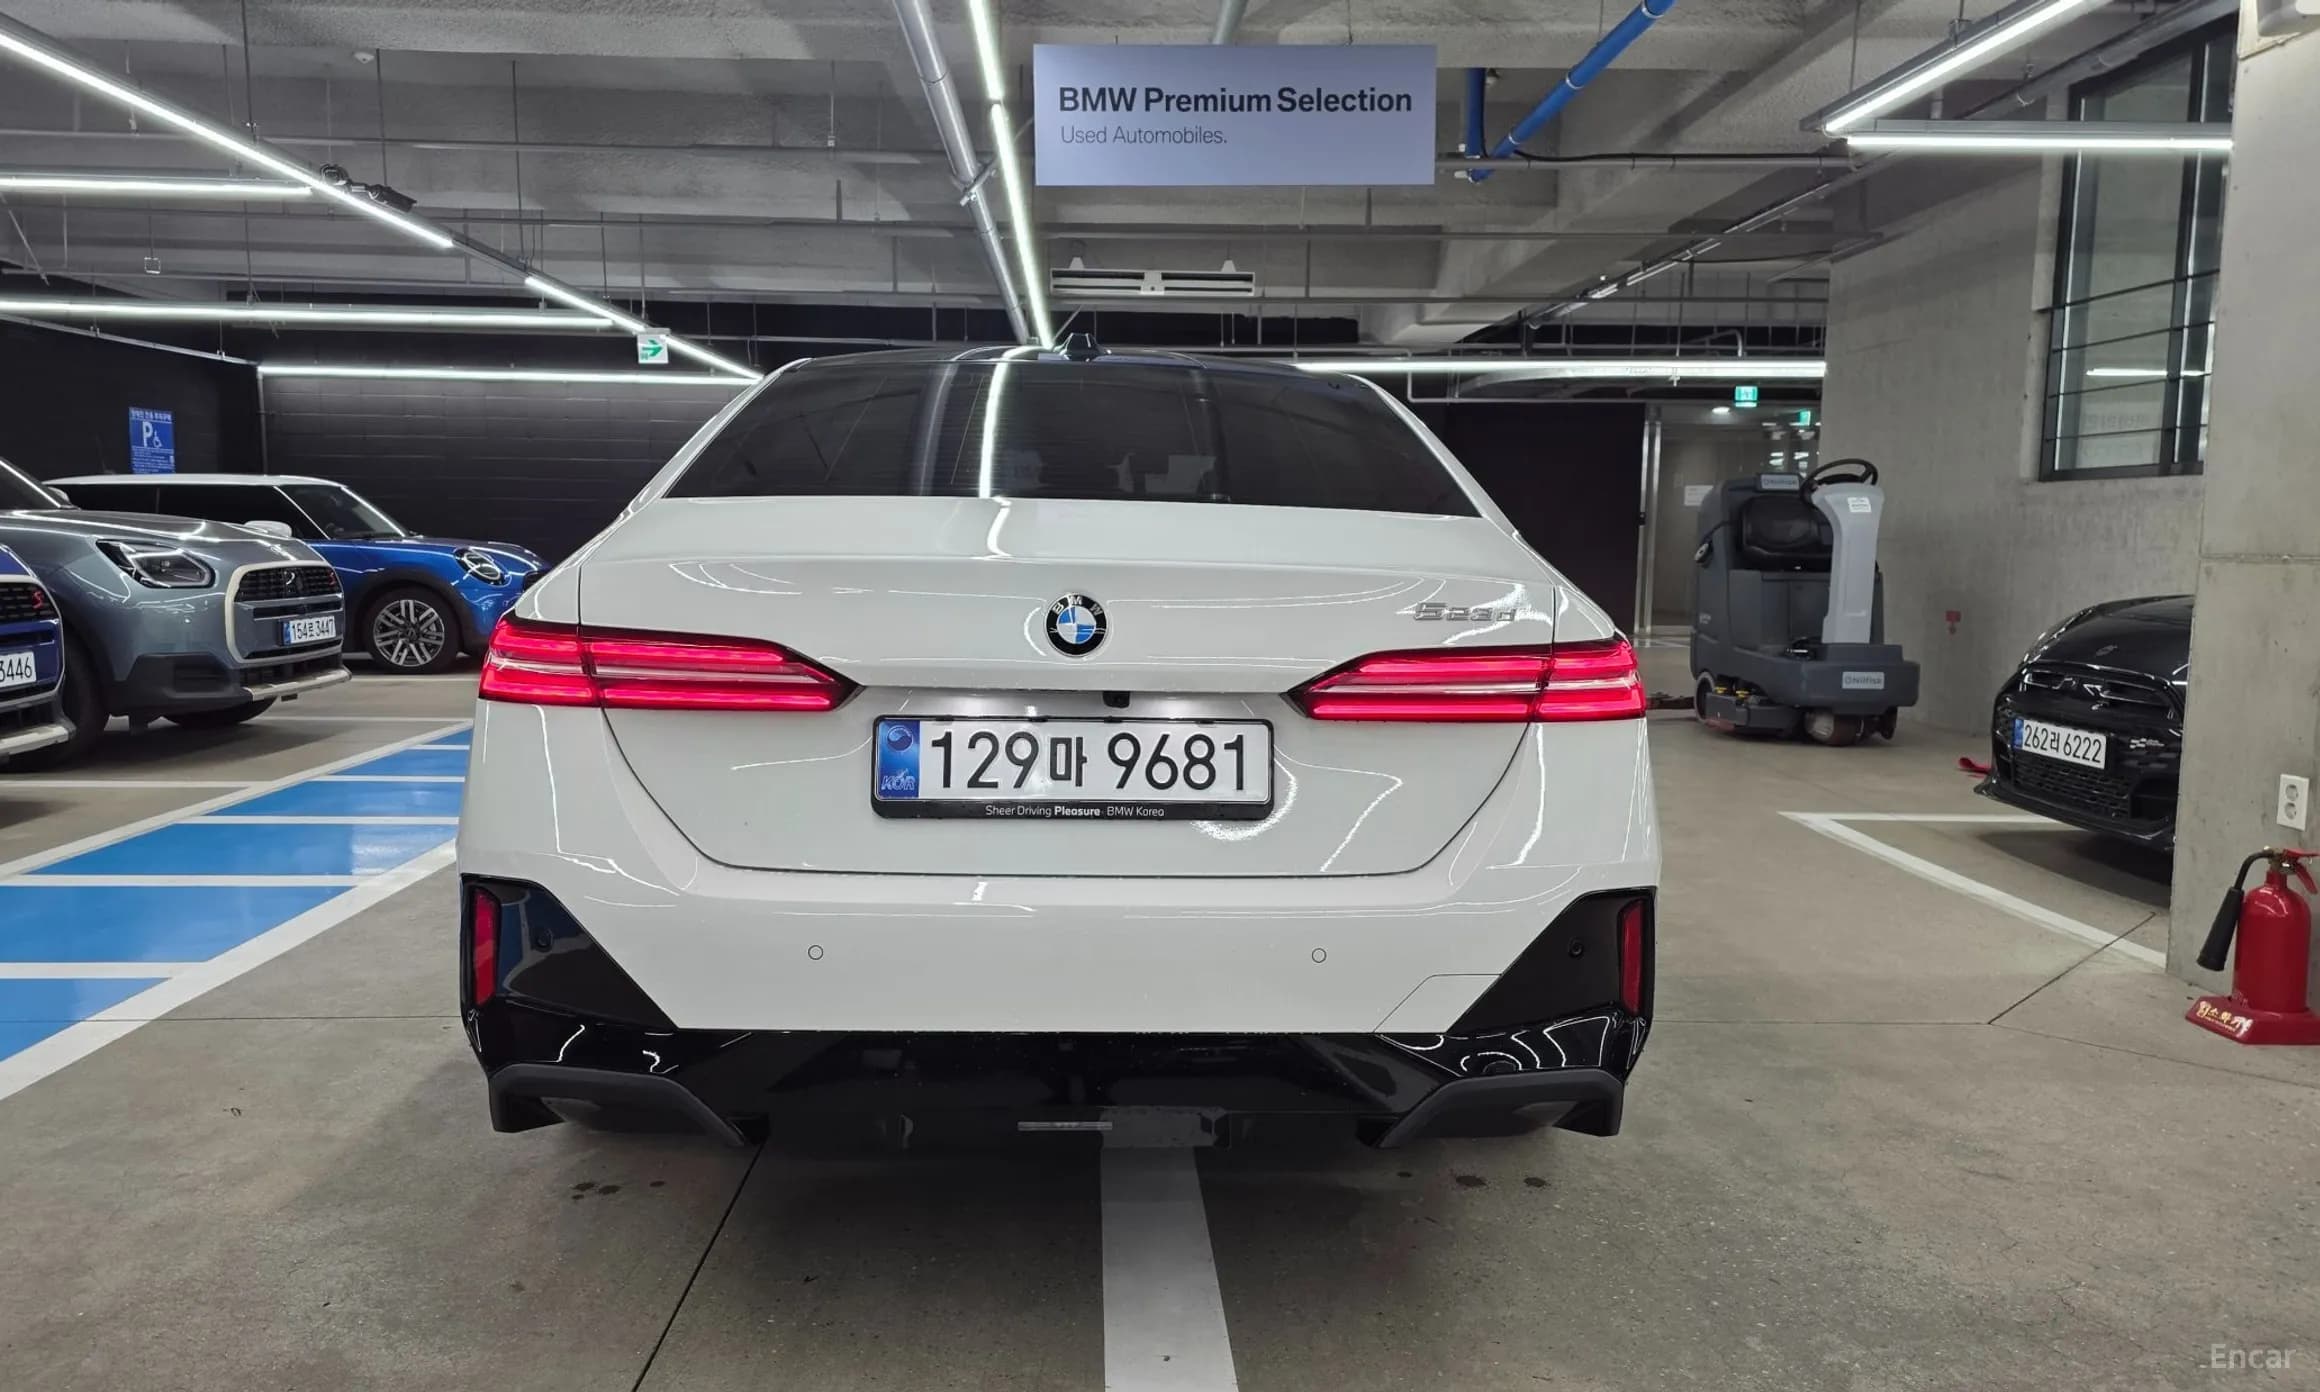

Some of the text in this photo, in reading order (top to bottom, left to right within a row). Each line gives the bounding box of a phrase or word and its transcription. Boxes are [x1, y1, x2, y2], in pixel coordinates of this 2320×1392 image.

[1059, 86, 1413, 112] BMW Premium Selection
[1060, 125, 1228, 144] Used Automobiles.
[142, 420, 154, 448] P
[931, 730, 1249, 791] 129마 9681
[2063, 733, 2102, 764] 6222
[985, 804, 1165, 818] Sheer Driving Pleasure BMW Korea
